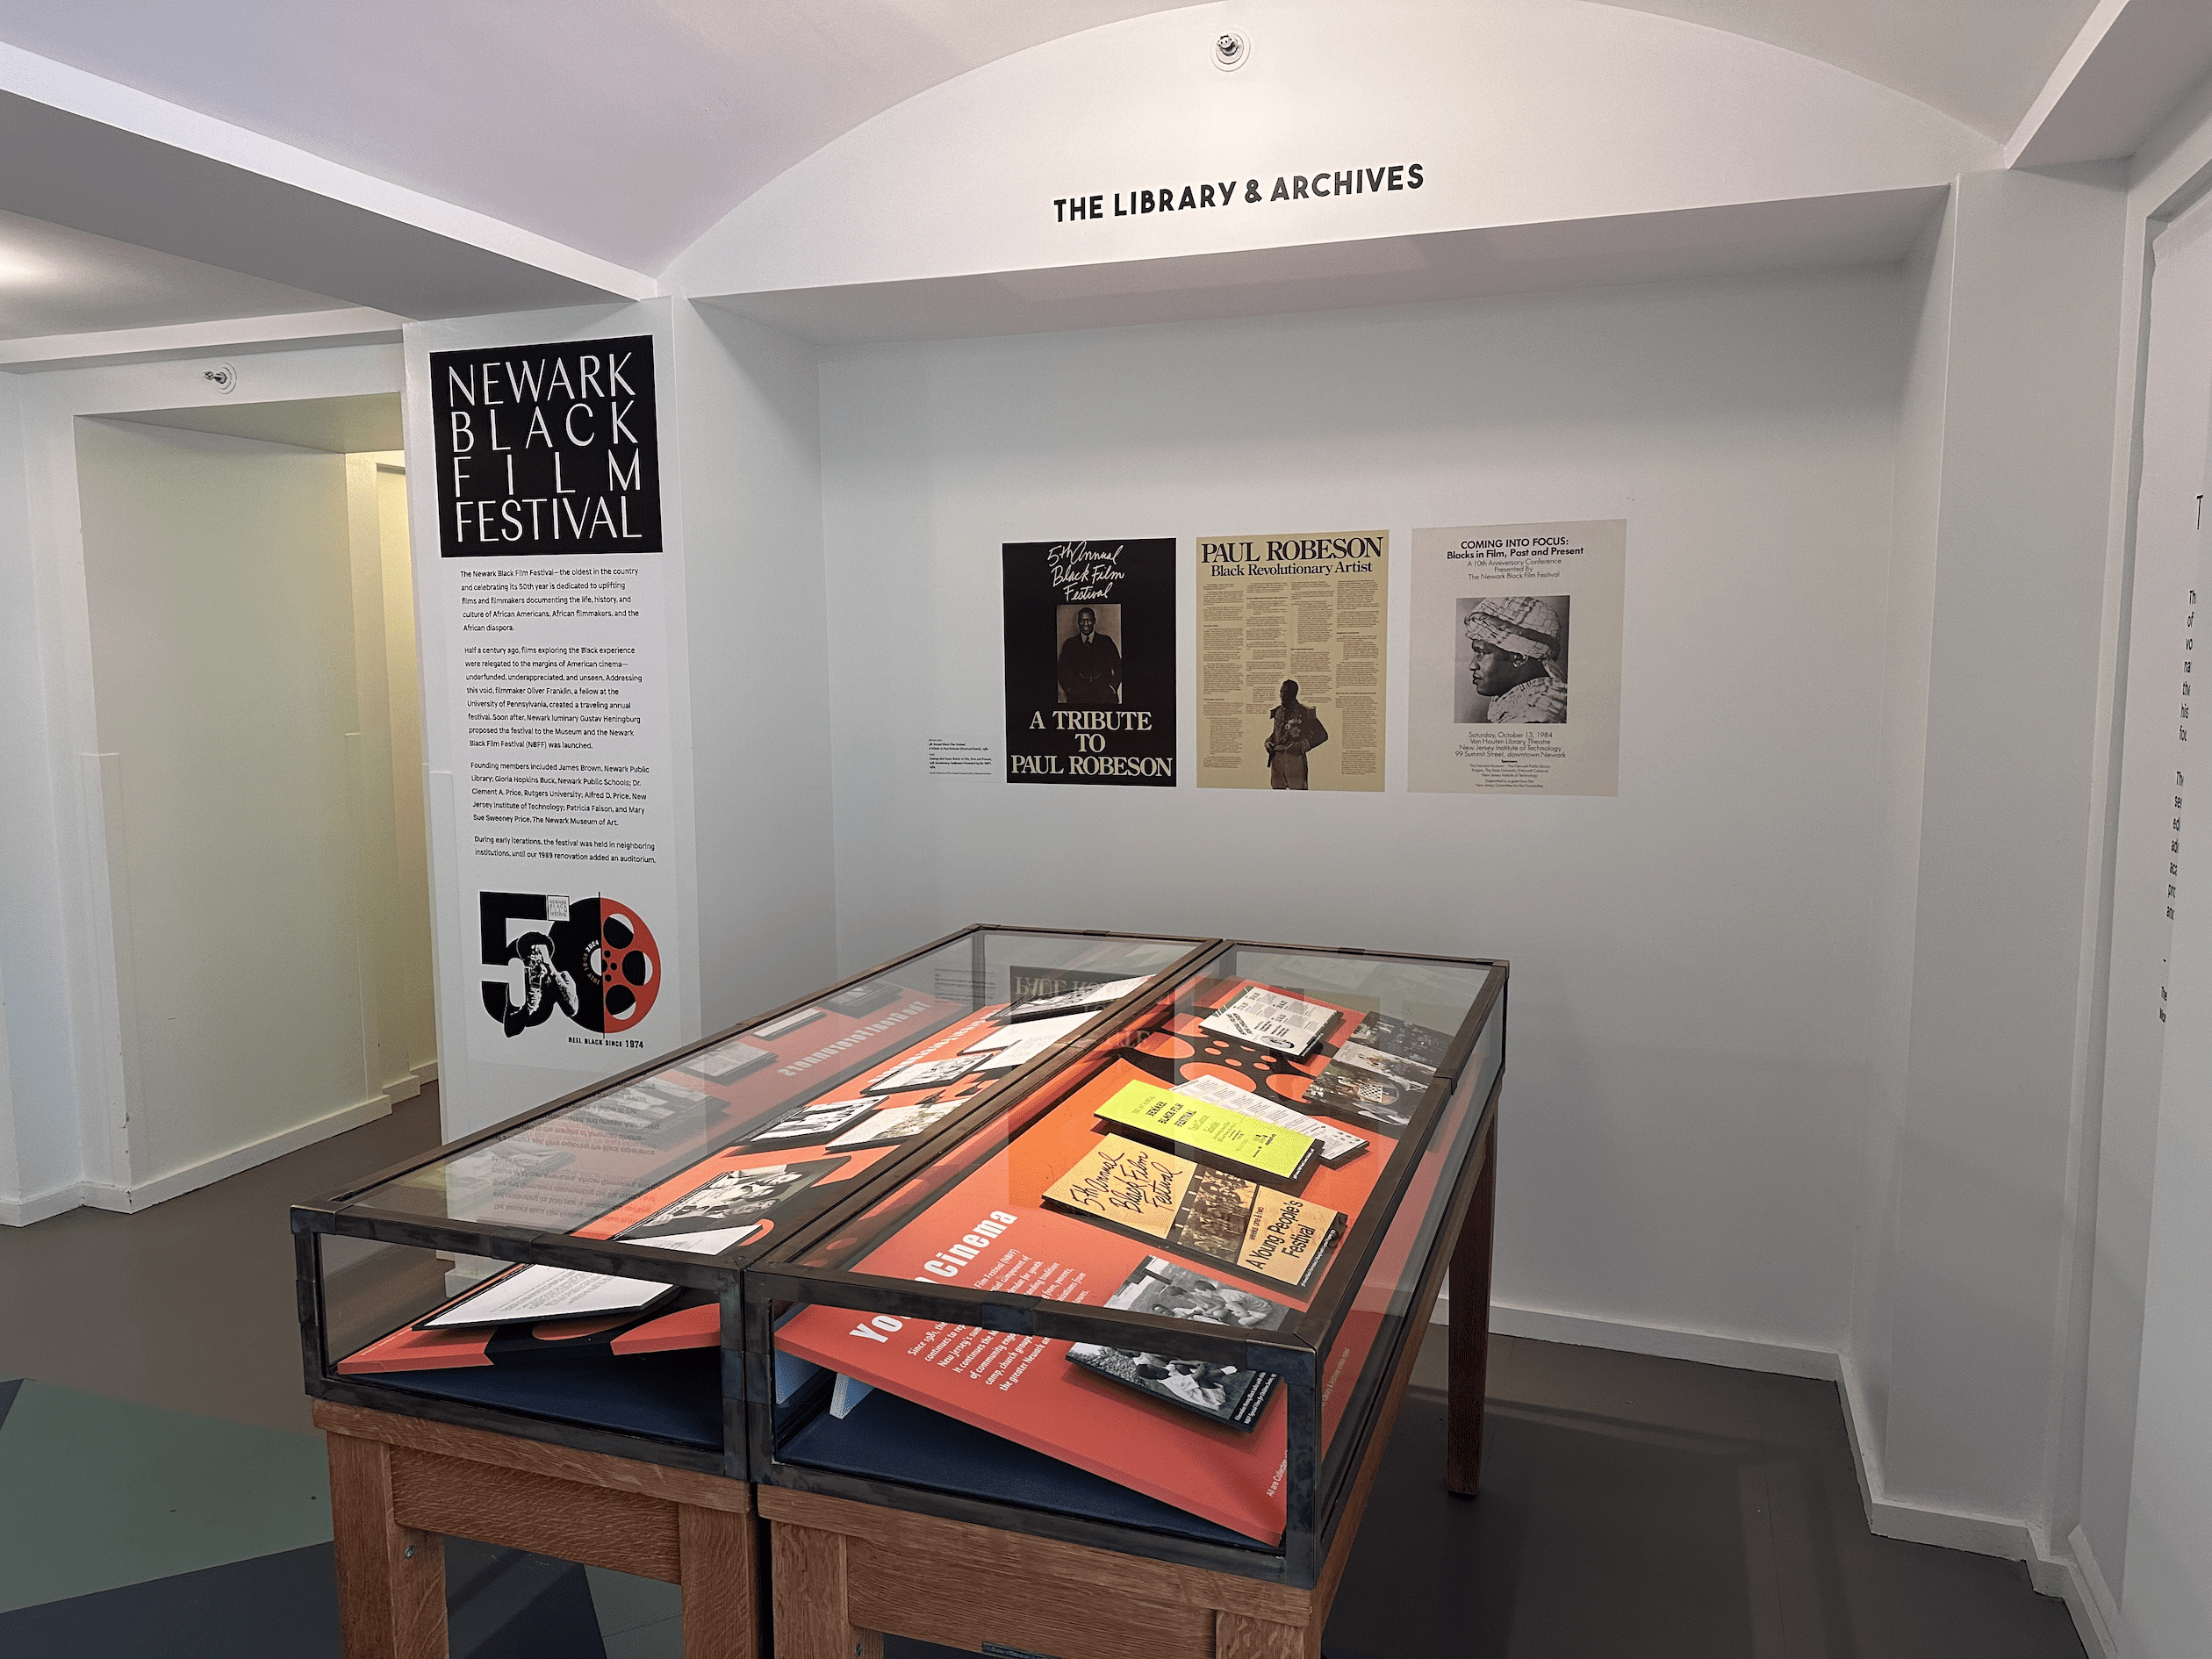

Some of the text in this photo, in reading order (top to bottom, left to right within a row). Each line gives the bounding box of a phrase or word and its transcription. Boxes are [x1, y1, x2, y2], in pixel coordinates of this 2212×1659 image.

[1054, 163, 1424, 222] THE LIBRARY & ARCHIVES
[449, 352, 635, 407] NEWARK
[451, 400, 638, 453] BLACK
[454, 448, 640, 497] FILM
[457, 496, 643, 542] FESTIVAL
[1047, 541, 1123, 567] 5th Annual
[1202, 537, 1384, 563] PAUL ROBESON
[1447, 547, 1584, 559] Blacks in Film, Past and Present
[1461, 537, 1569, 549] COMING INTO FOCUS:
[1051, 563, 1125, 587] Black Film
[1211, 561, 1372, 576] Black Revolutionary Artist
[1488, 559, 1524, 567] Anniversary
[473, 583, 508, 592] celebrating
[598, 581, 625, 590] uplifting
[1064, 582, 1113, 602] Festival
[486, 624, 514, 632] diaspora.
[1029, 711, 1152, 731] A TRIBUTE
[1074, 734, 1106, 753] TO
[1011, 755, 1064, 774] PAUL
[1069, 756, 1173, 776] ROBESON
[475, 848, 511, 857] institutions,
[620, 855, 656, 863] auditorium.
[585, 940, 599, 952] 2024
[625, 1040, 644, 1049] 1974
[1070, 1152, 1124, 1210] 5th Annual
[1109, 1151, 1149, 1213] Black Film
[1144, 1161, 1182, 1211] Festival
[924, 1210, 1018, 1277] Cinema
[1246, 1200, 1304, 1270] A Young People's
[1281, 1224, 1316, 1258] Festival
[908, 1322, 948, 1355] Since 1981, the
[925, 1337, 952, 1361] continues
[937, 1336, 973, 1367] New Jersey's
[960, 1344, 985, 1368] continues
[981, 1336, 993, 1344] the
[970, 1345, 1007, 1379] of community
[985, 1370, 1005, 1385] camp,
[999, 1352, 1018, 1369] church
[999, 1344, 1046, 1391] the greater Newark
